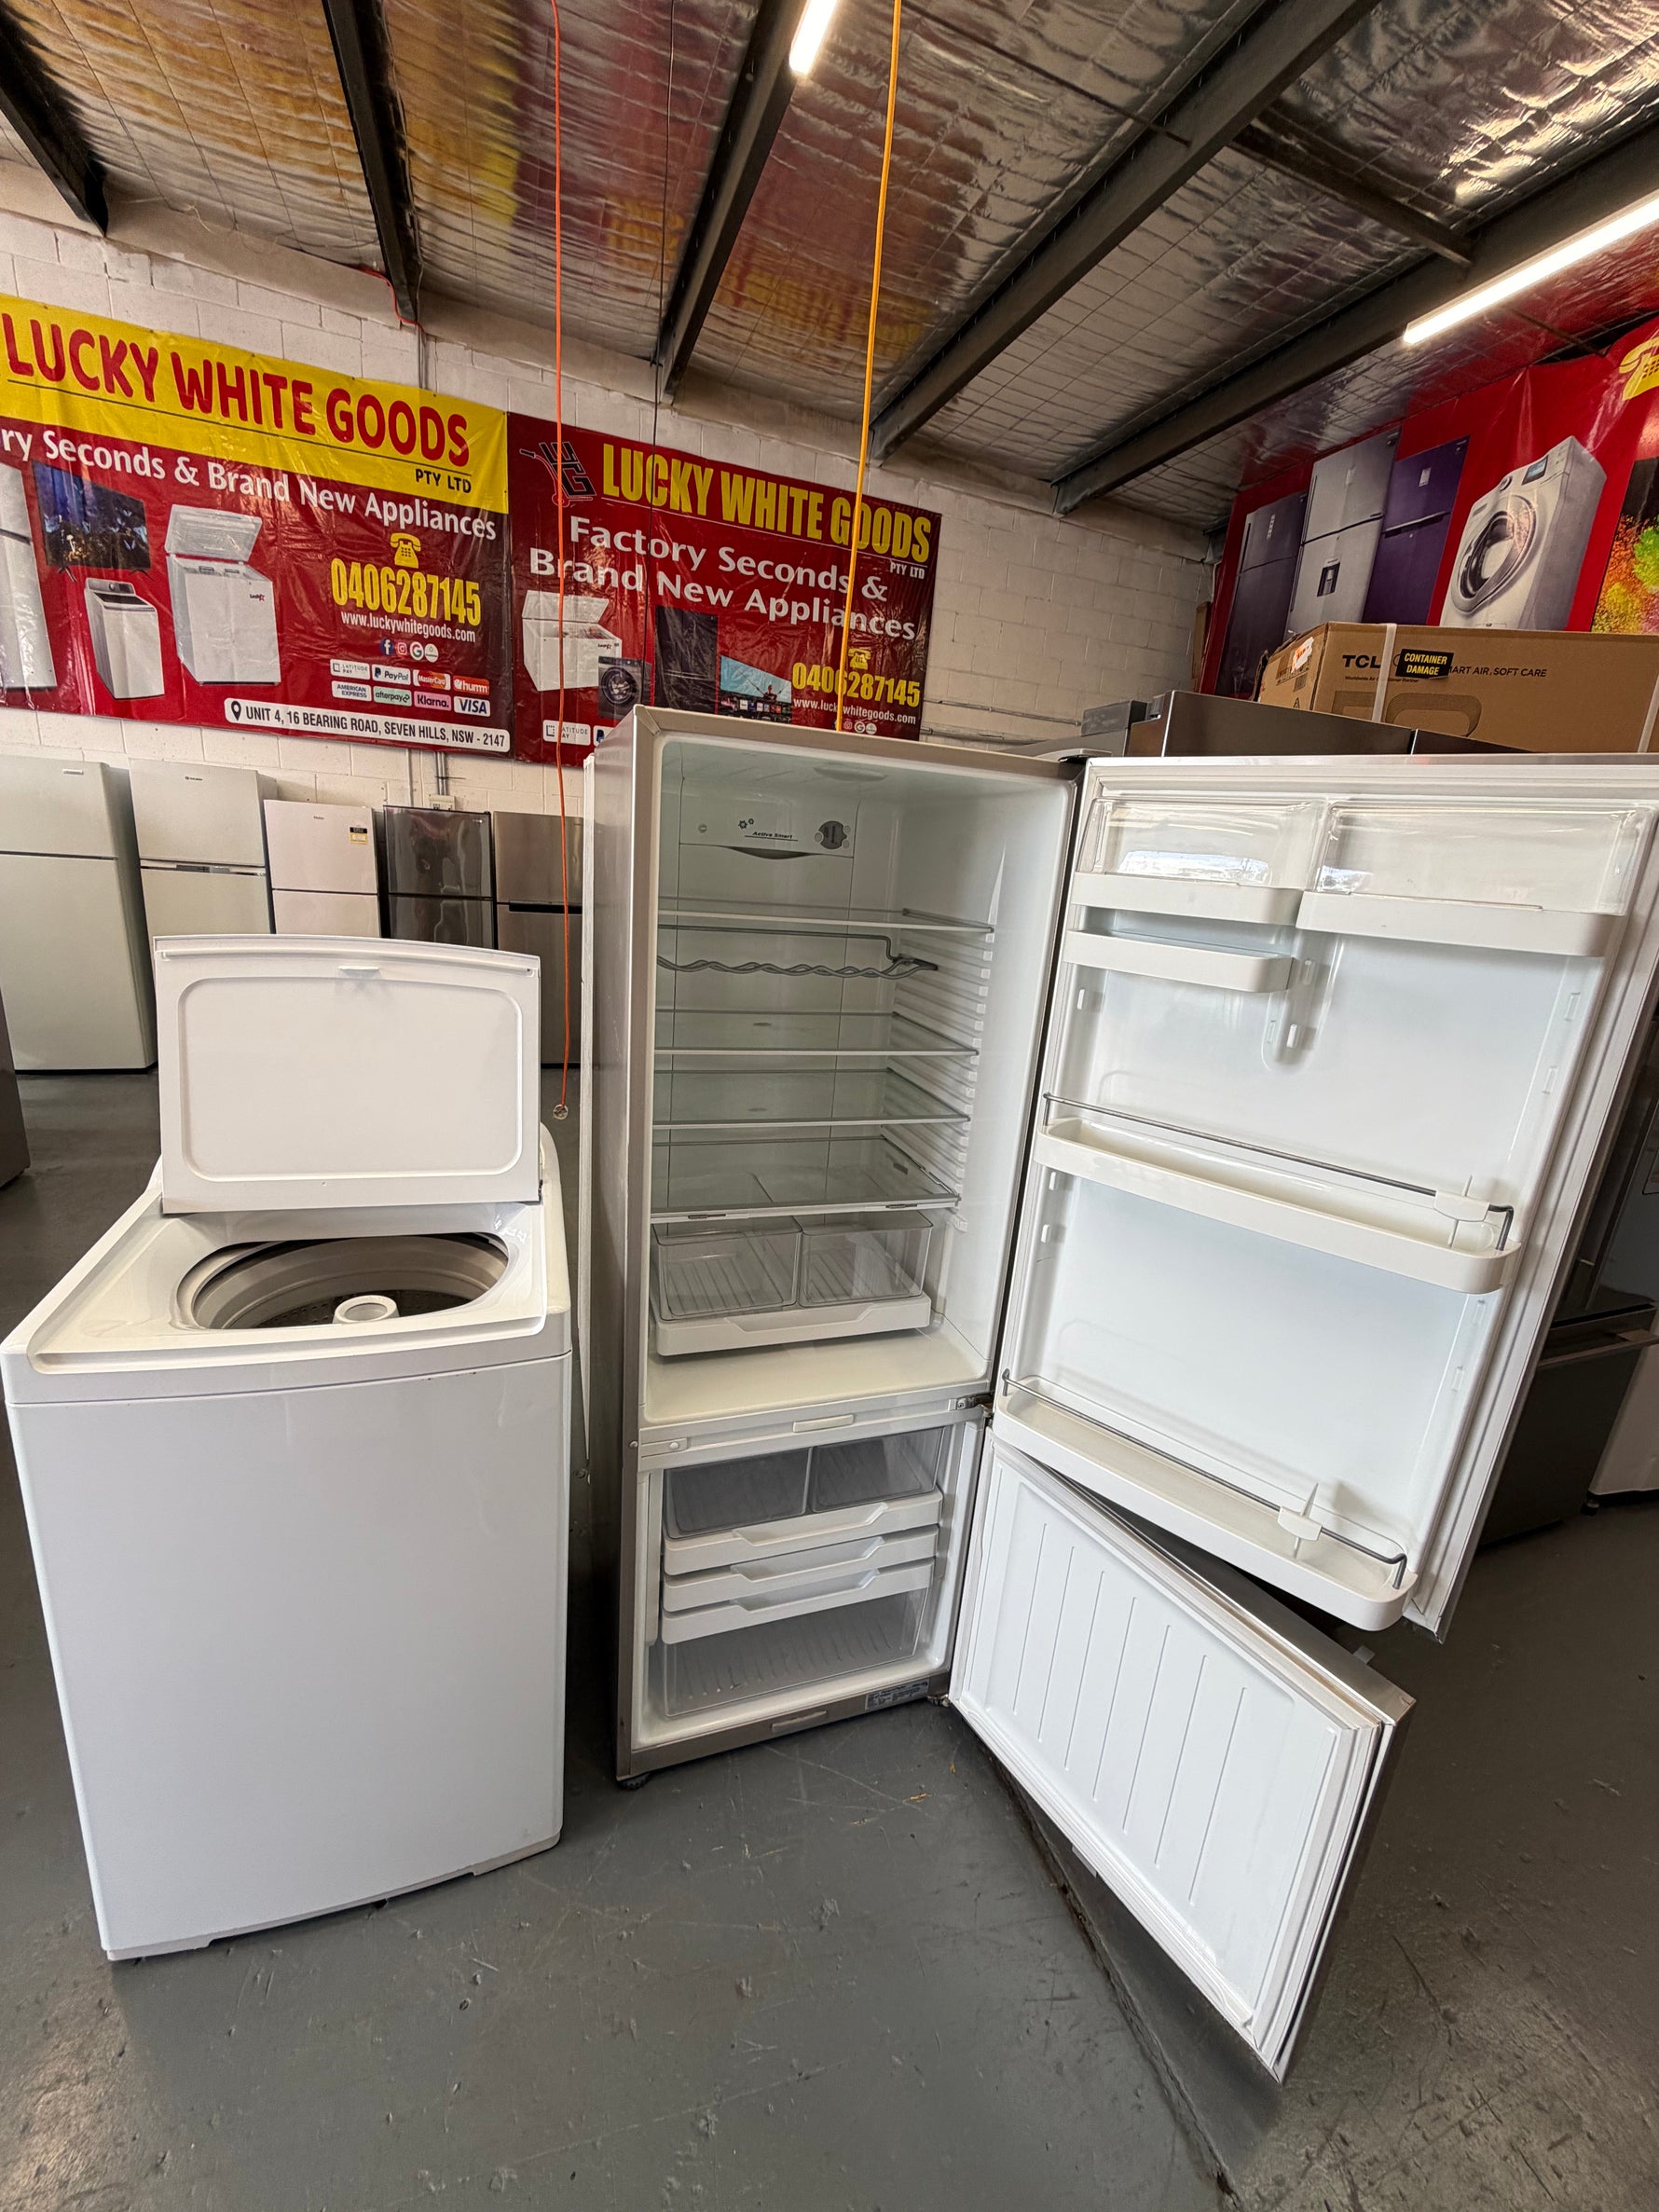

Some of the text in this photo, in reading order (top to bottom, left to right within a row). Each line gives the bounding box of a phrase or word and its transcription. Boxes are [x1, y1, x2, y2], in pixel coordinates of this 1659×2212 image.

[2, 313, 470, 467] LUCKY WHITE GOODS
[43, 430, 166, 480] Seconds
[174, 456, 199, 487] &
[208, 461, 289, 501] Brand
[299, 480, 356, 514] New
[364, 492, 497, 541] Appliances
[416, 469, 472, 494] PTY LTD
[603, 443, 931, 563] LUCKY WHITE GOODS
[570, 515, 887, 602] Factory Seconds &
[889, 562, 925, 580] PTY LTD
[331, 558, 482, 626] 0406287145
[530, 547, 915, 639] Brand New Appliances
[341, 611, 476, 643] www.luckywhitegoods.com
[1342, 654, 1380, 668] TCL
[1405, 653, 1447, 665] CONTAINER
[342, 664, 368, 672] LATITUDE
[384, 670, 408, 680] PayPal
[1405, 665, 1440, 676] DAMAGE
[1449, 666, 1472, 674] ART
[1493, 667, 1519, 676] SOFT
[1520, 668, 1547, 677] CARE
[336, 684, 366, 693] AMERICAN
[418, 675, 446, 685] MasterCard
[462, 680, 487, 694] humm
[792, 662, 920, 708] 0406287145
[375, 691, 403, 702] afterpay
[459, 698, 487, 714] VISA
[793, 698, 916, 724] www.luckwhitegoods.com
[246, 705, 271, 721] UNIT
[274, 709, 284, 724] 4,
[287, 710, 300, 725] 16
[303, 713, 348, 730] BEARING
[350, 718, 381, 735] ROAD,
[384, 721, 416, 737] SEVEN
[418, 725, 449, 742] HILLS,
[451, 729, 474, 744] NSW
[483, 732, 505, 748] 2147
[562, 726, 588, 735] ATITUDE
